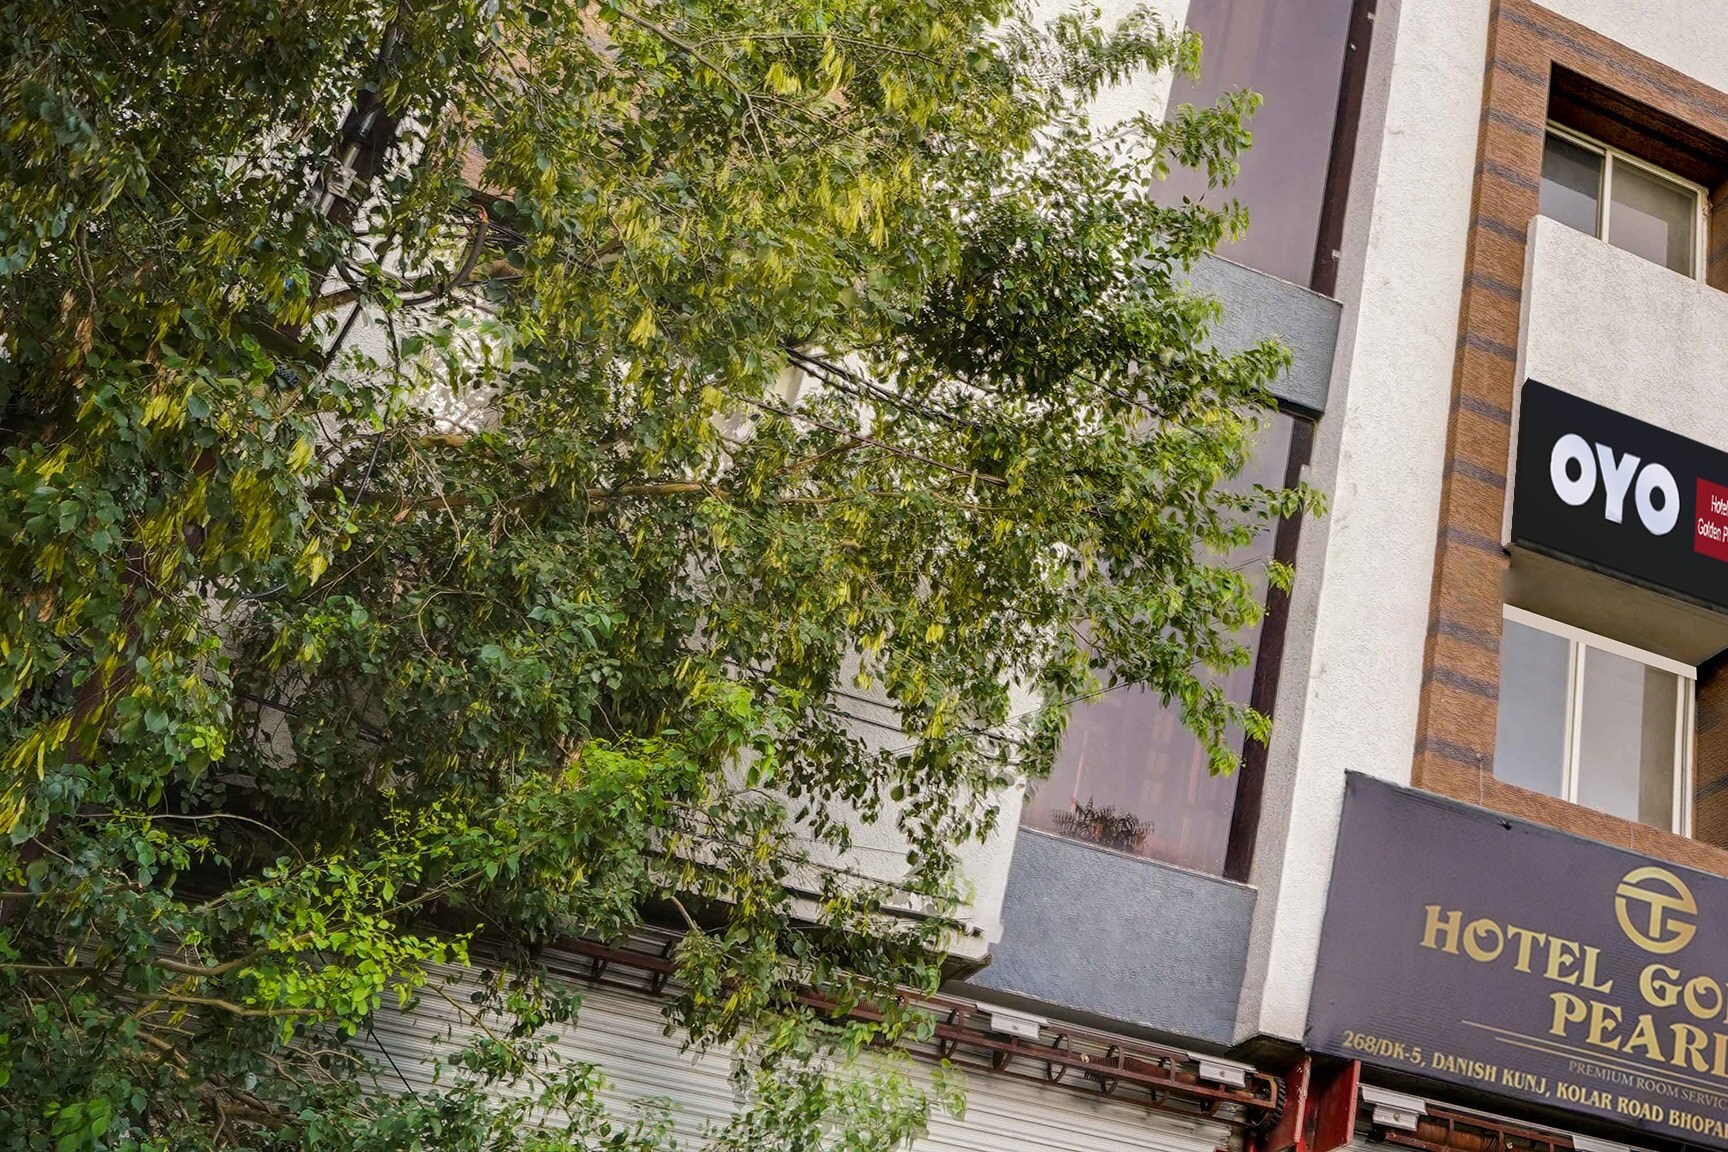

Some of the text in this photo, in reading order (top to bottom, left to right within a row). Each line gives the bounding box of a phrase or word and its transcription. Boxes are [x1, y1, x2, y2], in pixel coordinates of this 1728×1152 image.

[1550, 433, 1680, 536] OYO
[1711, 494, 1728, 517] Hotel
[1697, 517, 1722, 542] Golden
[1420, 904, 1614, 994] HOTEL
[1342, 1030, 1427, 1068] 268/DK-5,
[1431, 1051, 1497, 1083] DANISH
[1501, 1069, 1552, 1098] KUNJ,
[1556, 1081, 1613, 1110] KOLAR
[1616, 1098, 1664, 1124] ROAD
[1568, 1059, 1634, 1087] PREMIUM
[1635, 1076, 1679, 1098] ROOM
